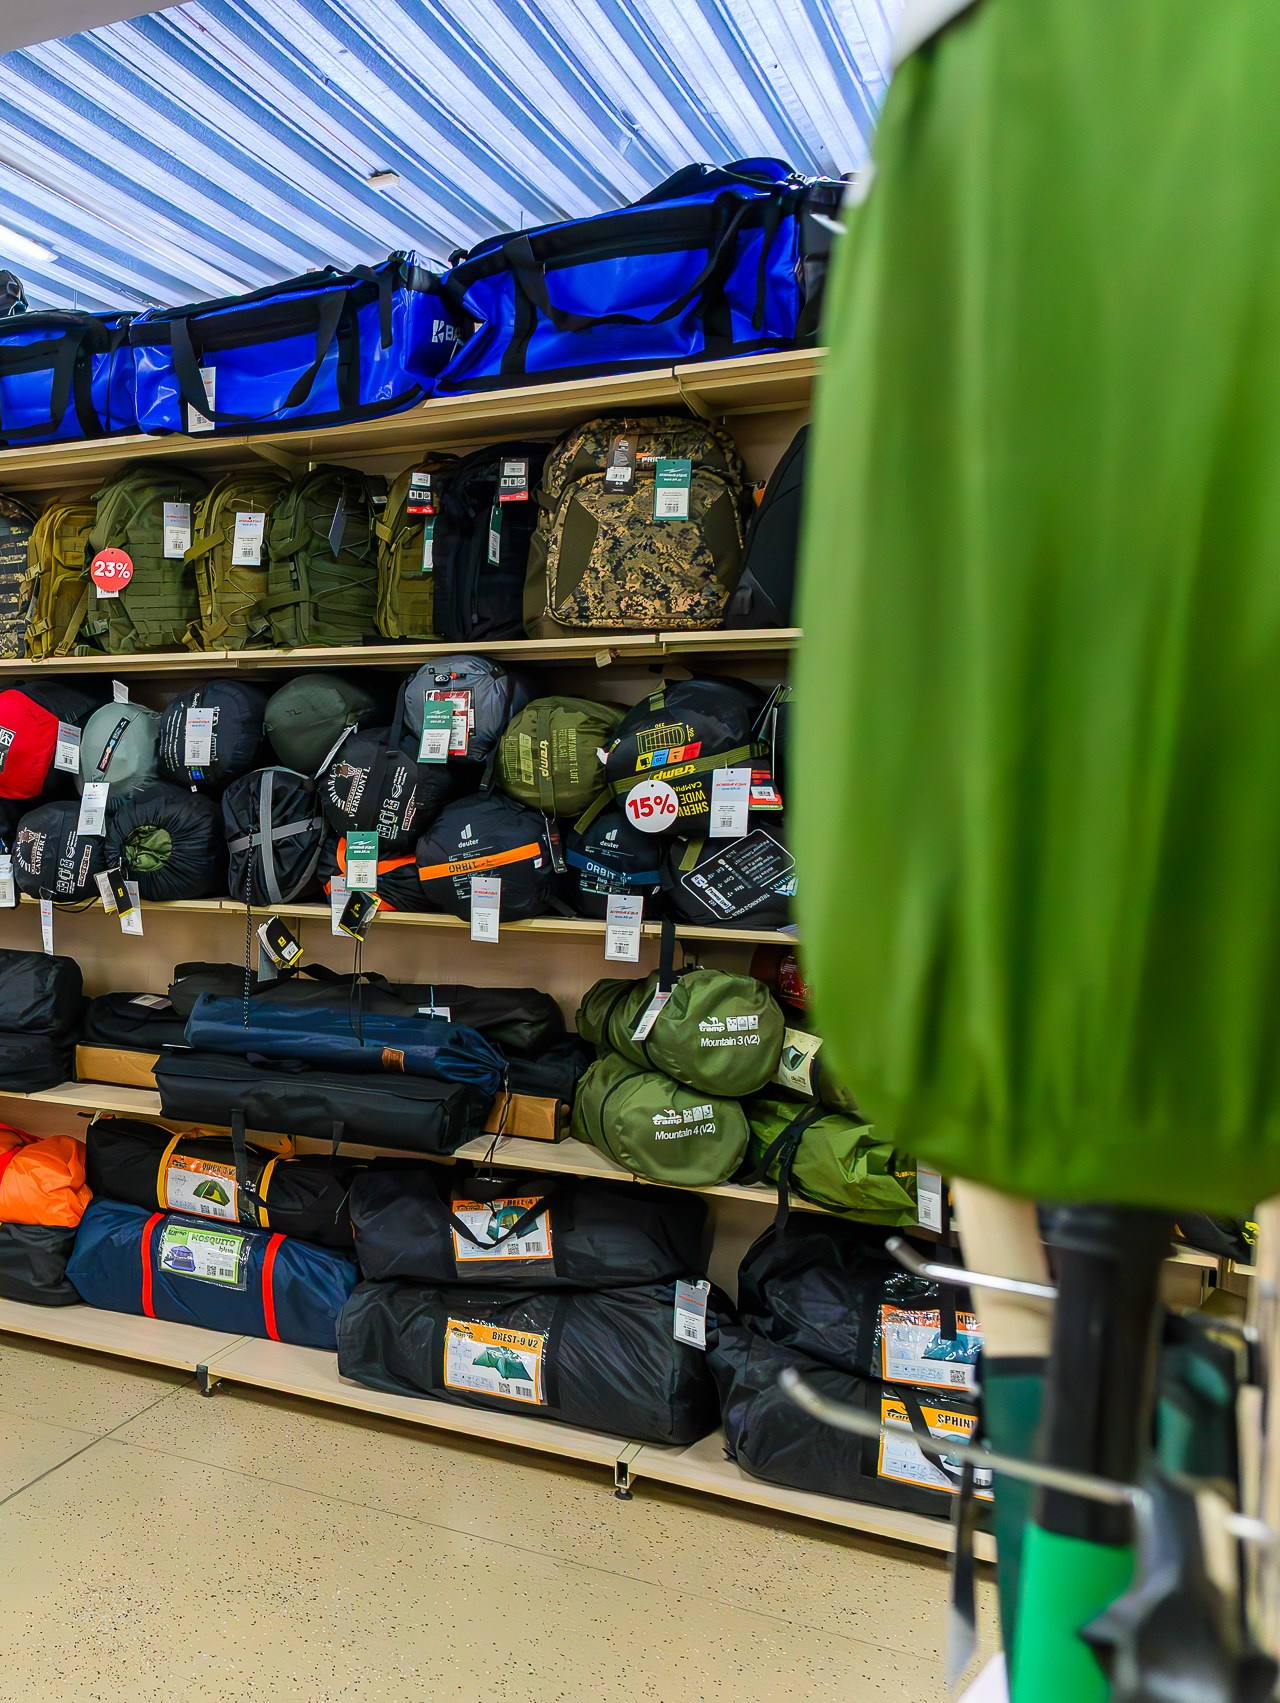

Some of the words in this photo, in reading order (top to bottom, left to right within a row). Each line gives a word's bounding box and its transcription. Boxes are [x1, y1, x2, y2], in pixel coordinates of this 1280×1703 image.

[93, 560, 131, 579] 23%
[538, 739, 551, 777] tramp
[653, 764, 696, 780] tramp
[328, 773, 346, 811] INDIANA
[349, 776, 367, 818] VERMONT
[681, 790, 705, 804] WIDE
[628, 794, 676, 819] 15%
[458, 838, 479, 849] deuter
[599, 840, 619, 850] deuter
[35, 841, 46, 875] CAMPER
[448, 861, 477, 874] ORBIT
[586, 862, 616, 880] ORBIT
[698, 1024, 725, 1032] tramp
[701, 1038, 737, 1047] Mountain
[737, 1038, 744, 1046] 3
[744, 1034, 760, 1046] (V2)
[653, 1117, 683, 1126] tramp
[655, 1130, 693, 1140] Mountain
[693, 1129, 699, 1137] 4
[699, 1123, 716, 1136] (V2)
[191, 1233, 236, 1247] MOSQUITO
[492, 1331, 526, 1346] BREST-9
[527, 1340, 539, 1349] V2
[937, 1414, 980, 1429] SPHIN
